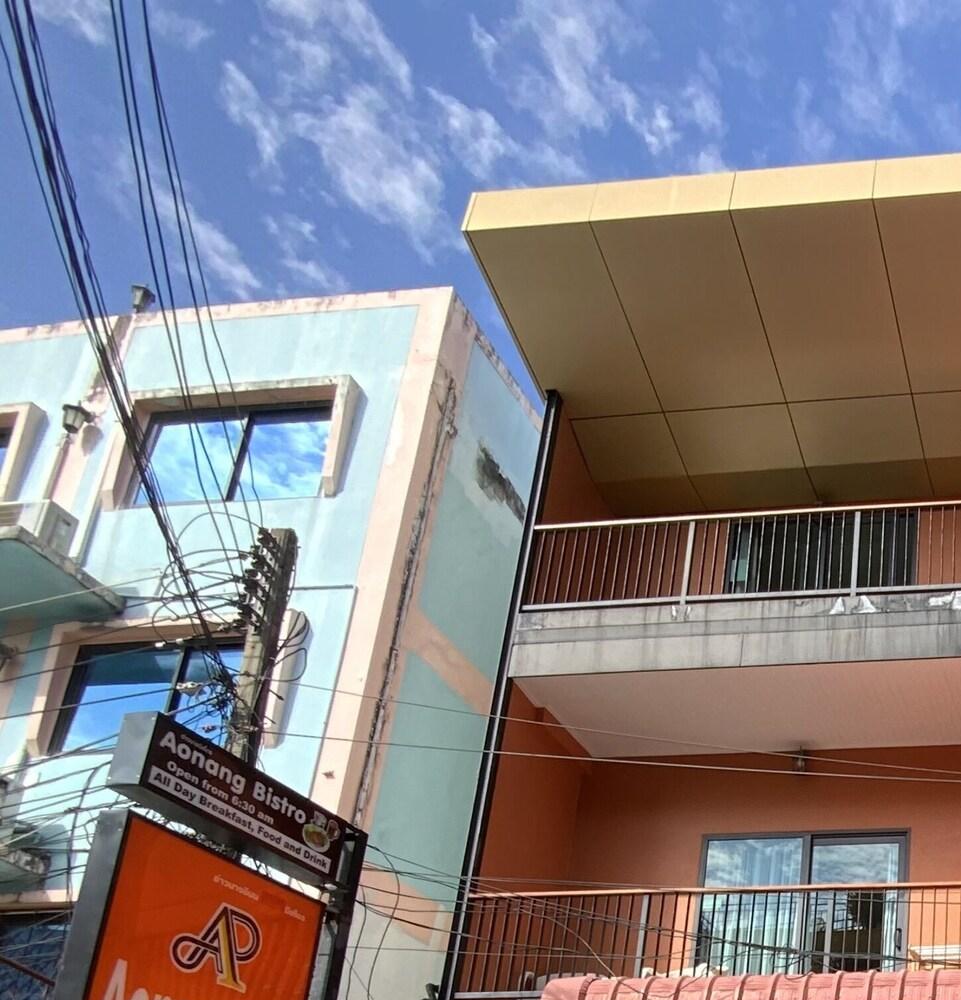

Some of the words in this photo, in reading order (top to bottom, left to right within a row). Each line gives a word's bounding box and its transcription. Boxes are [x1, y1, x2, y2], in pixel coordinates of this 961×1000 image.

[152, 771, 169, 788] All
[173, 779, 198, 803] Day
[199, 793, 255, 833] Breakfast,
[256, 825, 282, 848] Food
[283, 840, 301, 856] and
[303, 849, 328, 869] Drink
[159, 731, 248, 795] Aonang
[252, 781, 307, 824] Bistro
[167, 760, 199, 786] Open
[201, 779, 229, 801] from
[231, 795, 255, 815] 6:30
[257, 810, 275, 825] am
